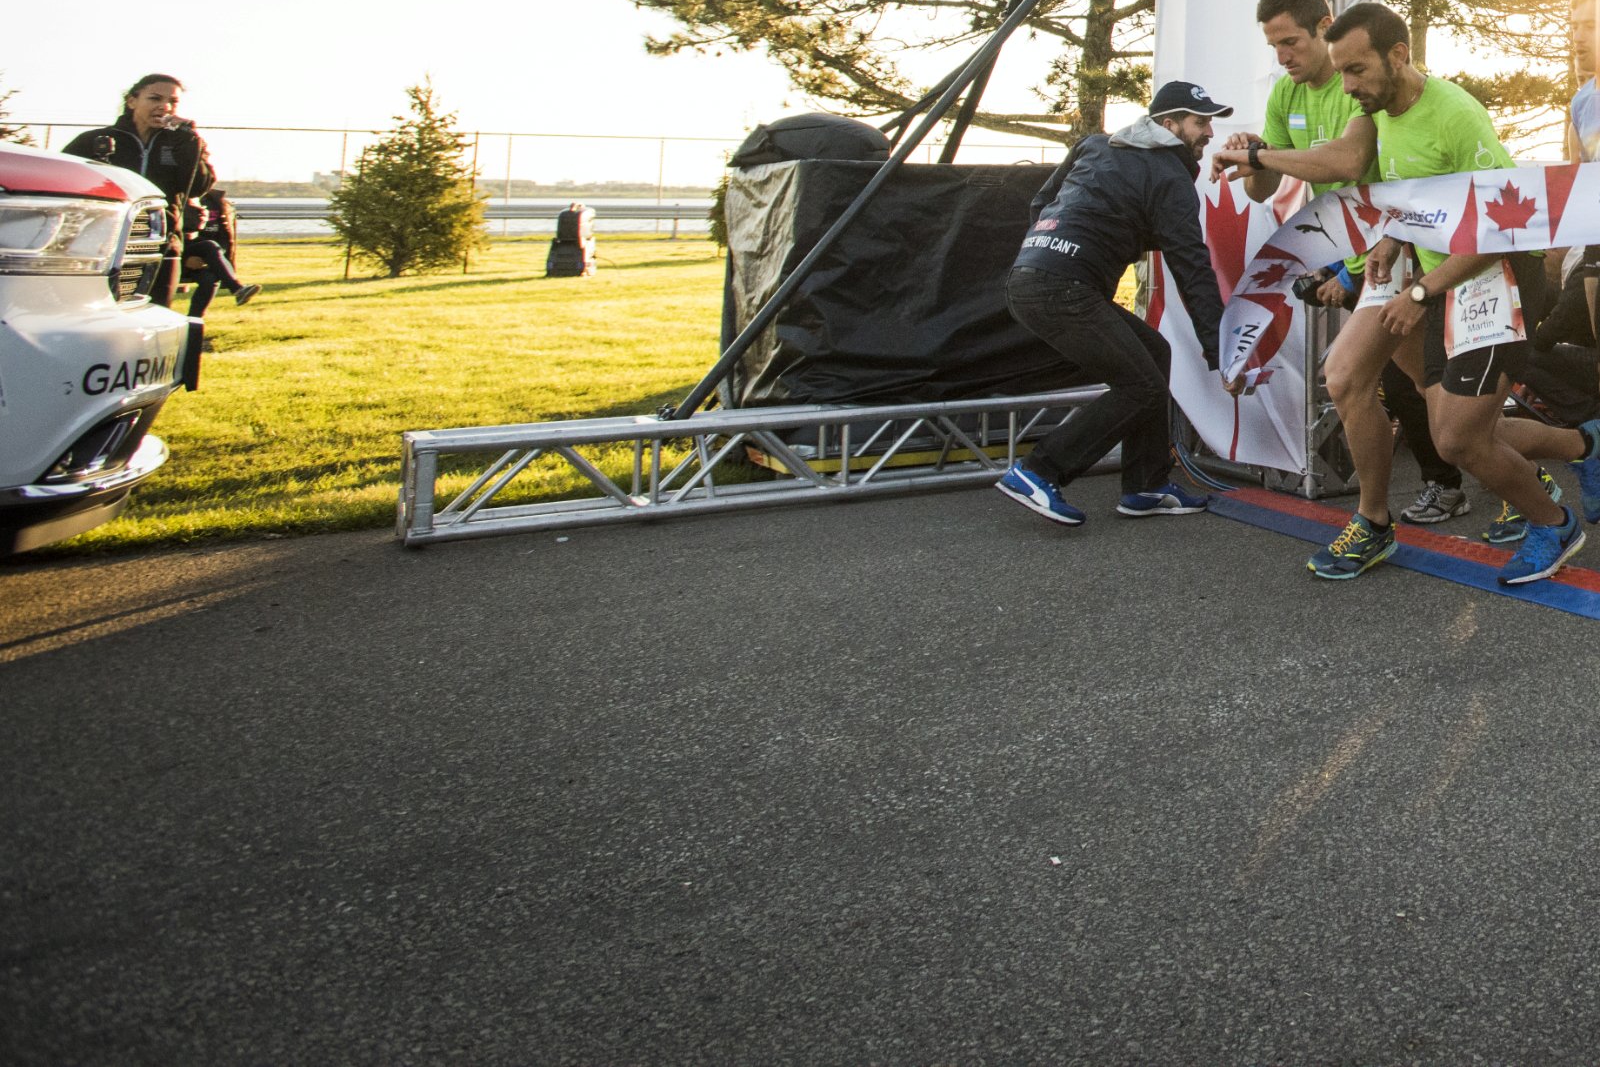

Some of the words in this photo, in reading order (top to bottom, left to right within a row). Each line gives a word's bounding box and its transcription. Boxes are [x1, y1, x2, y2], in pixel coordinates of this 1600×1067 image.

[1034, 235, 1051, 248] WHO
[1050, 237, 1081, 257] CAN'T
[1460, 297, 1499, 323] 4547
[1467, 320, 1494, 333] Martin
